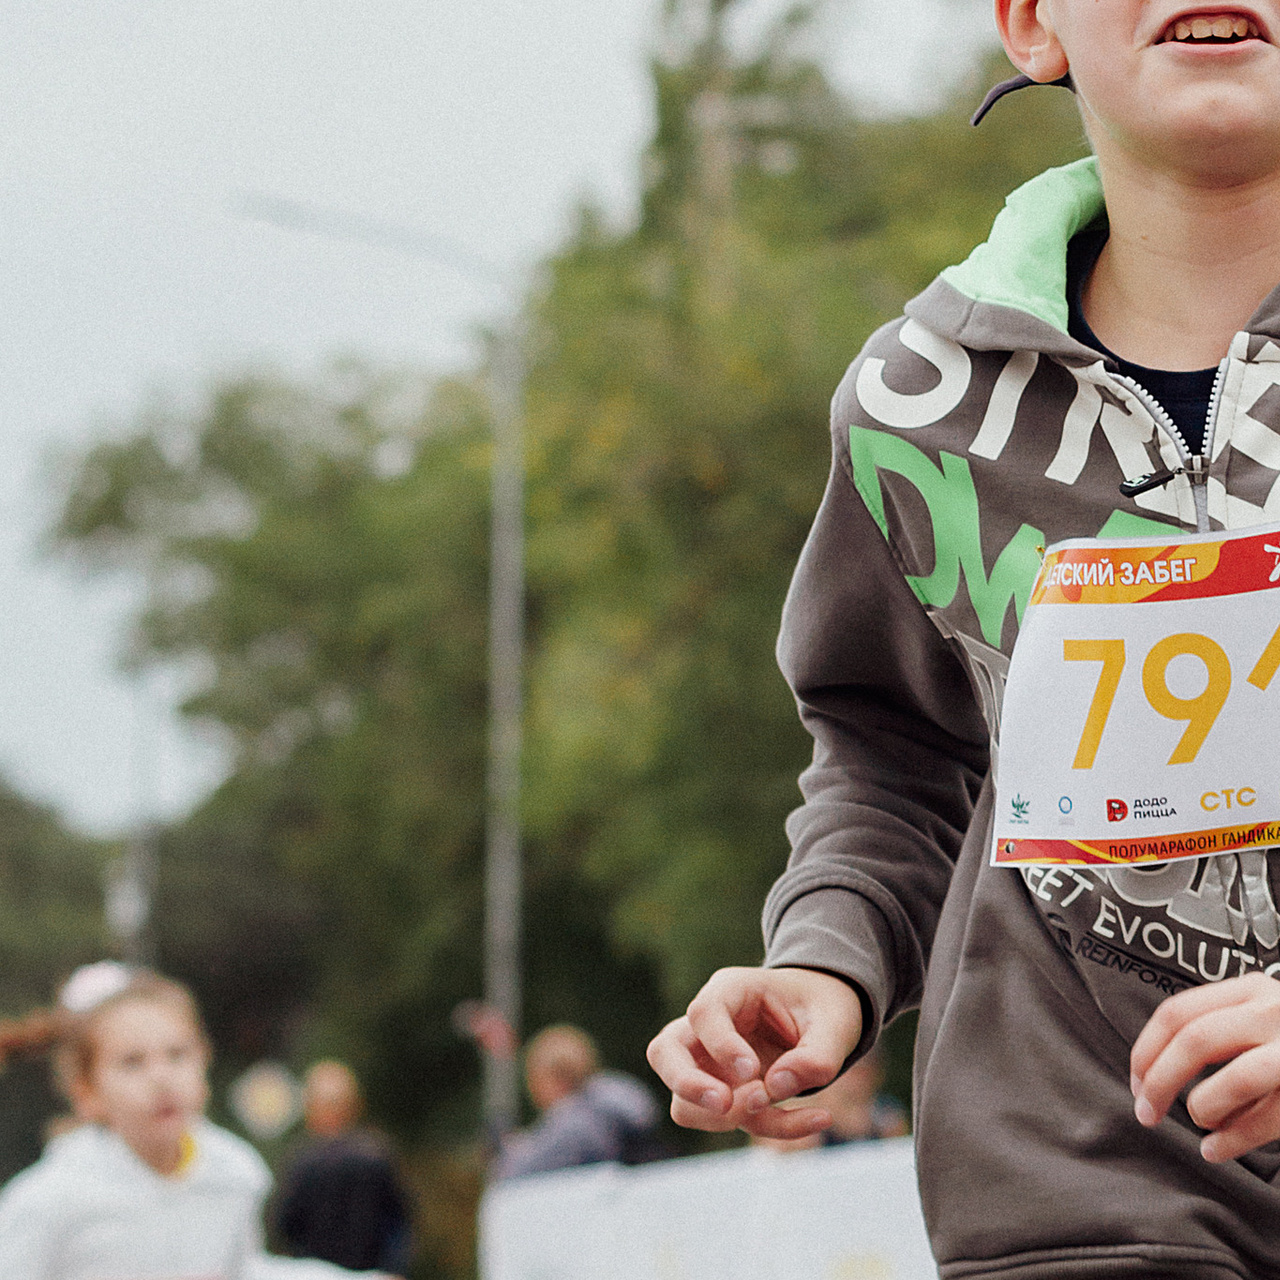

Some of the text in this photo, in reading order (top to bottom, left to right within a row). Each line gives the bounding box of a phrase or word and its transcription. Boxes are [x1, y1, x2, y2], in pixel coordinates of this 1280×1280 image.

[1120, 558, 1197, 585] ЗАБЕГ
[1133, 796, 1168, 808] ДОДО
[1200, 787, 1256, 812] СТС
[1133, 807, 1178, 820] ПИЦЦА
[1109, 835, 1218, 859] ПОЛУМАРАФОН
